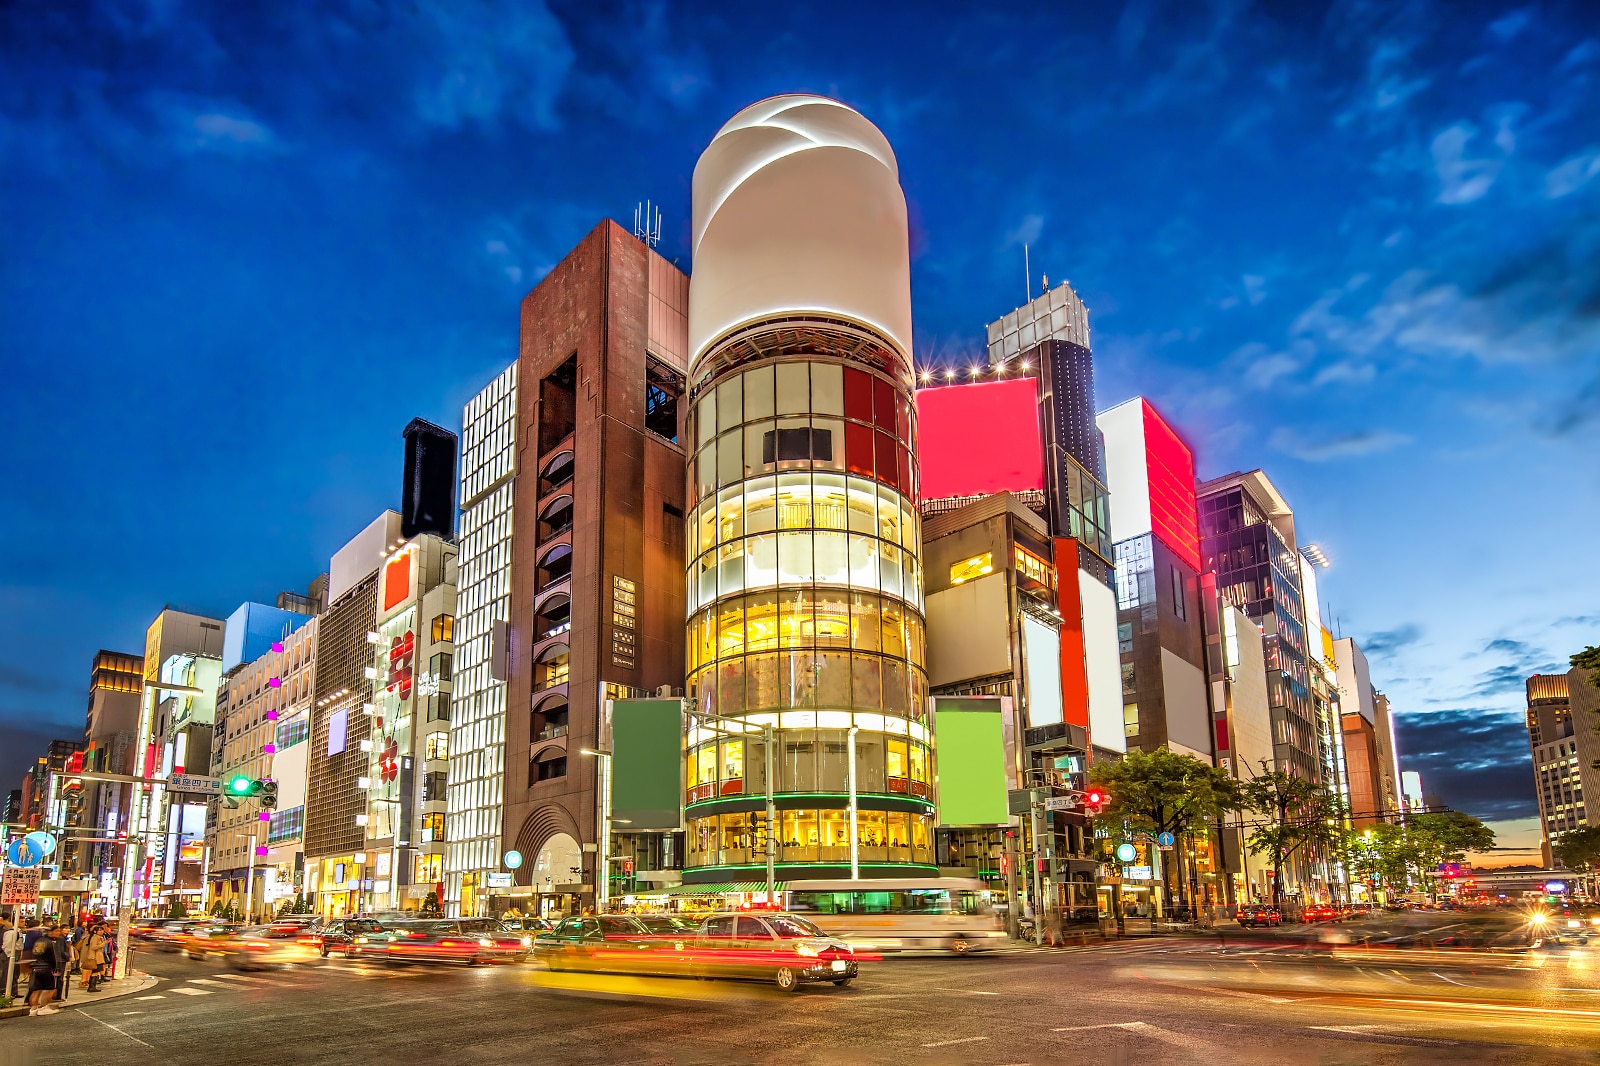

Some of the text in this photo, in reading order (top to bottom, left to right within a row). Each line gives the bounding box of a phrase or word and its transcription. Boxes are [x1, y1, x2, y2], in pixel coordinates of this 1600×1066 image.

[172, 778, 220, 788] 銀座四丁目
